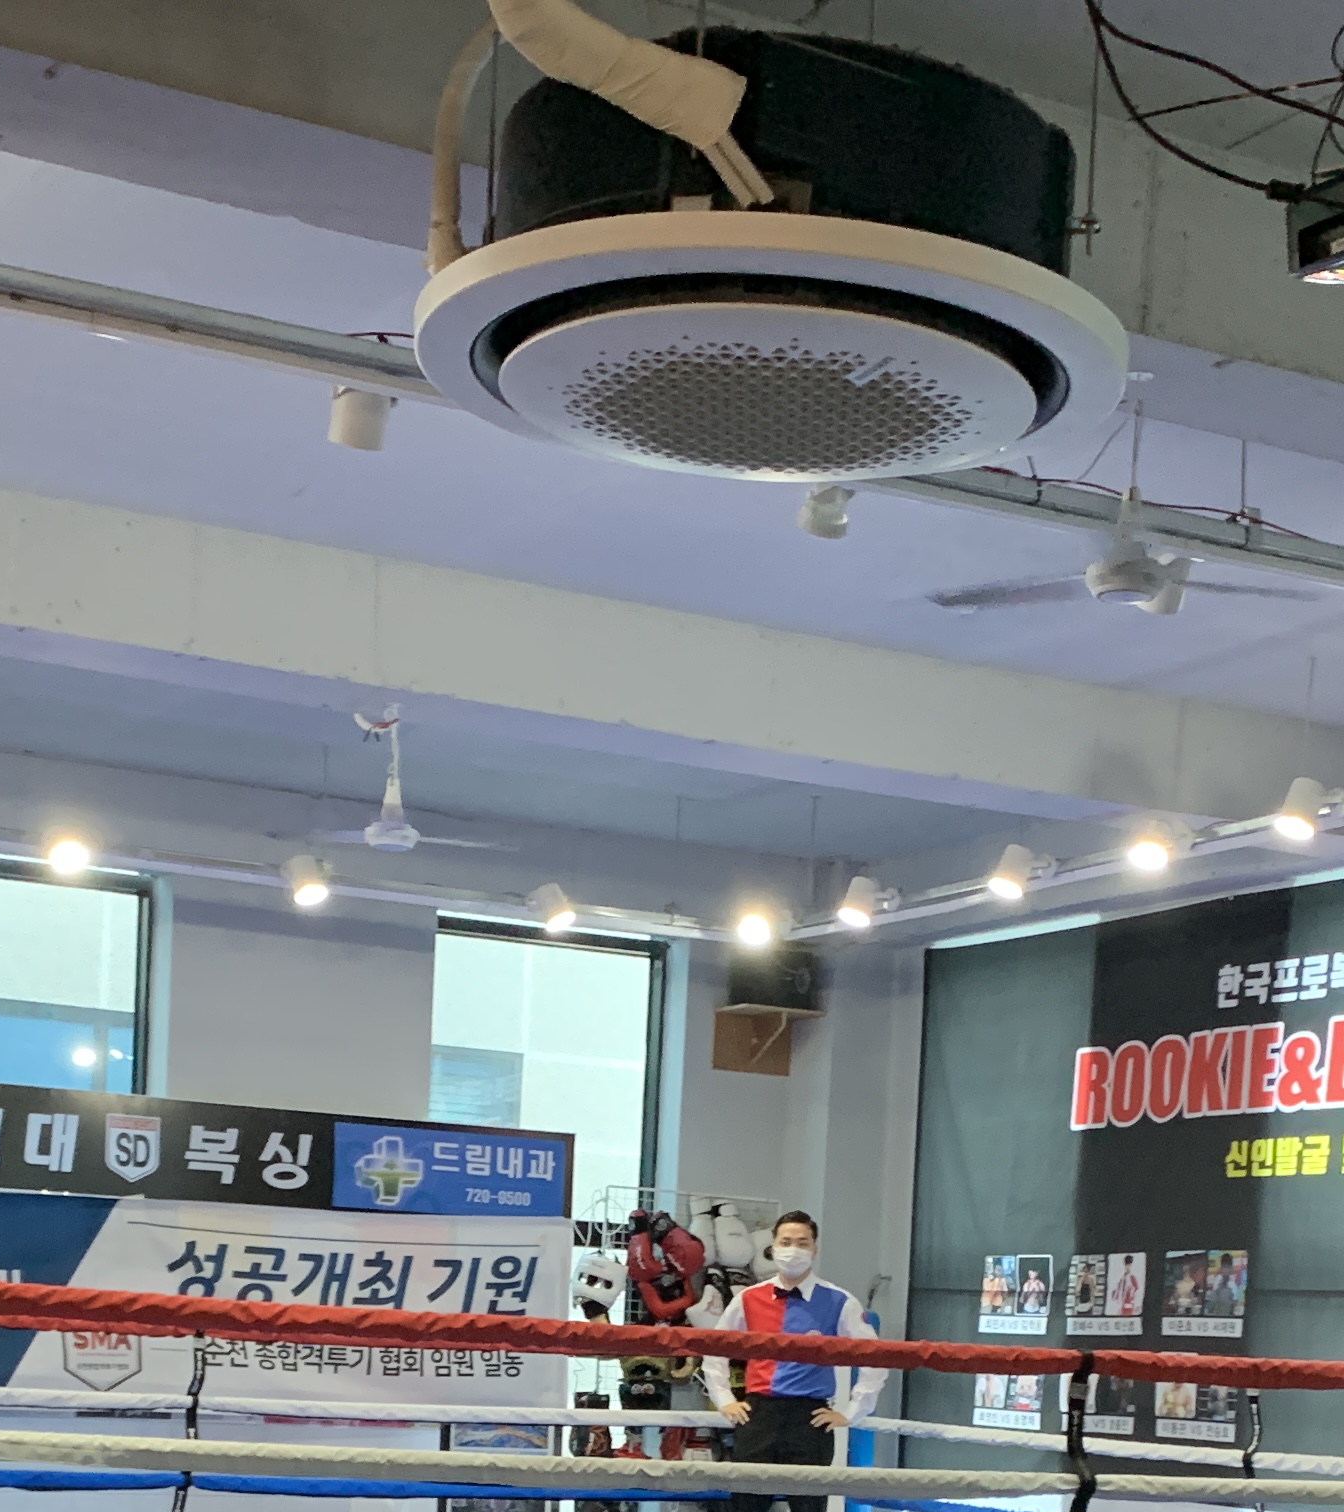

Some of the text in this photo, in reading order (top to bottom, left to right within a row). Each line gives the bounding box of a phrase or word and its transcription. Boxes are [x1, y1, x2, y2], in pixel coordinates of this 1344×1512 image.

[114, 1132, 152, 1168] SD
[183, 1124, 314, 1190] 복싱
[430, 1140, 556, 1182] 드림내과
[1224, 1134, 1331, 1178] 신인발굴
[167, 1240, 539, 1316] 성공개최 기원
[73, 1331, 132, 1350] SMA
[379, 1346, 425, 1377] 협회
[431, 1349, 476, 1378] 임원
